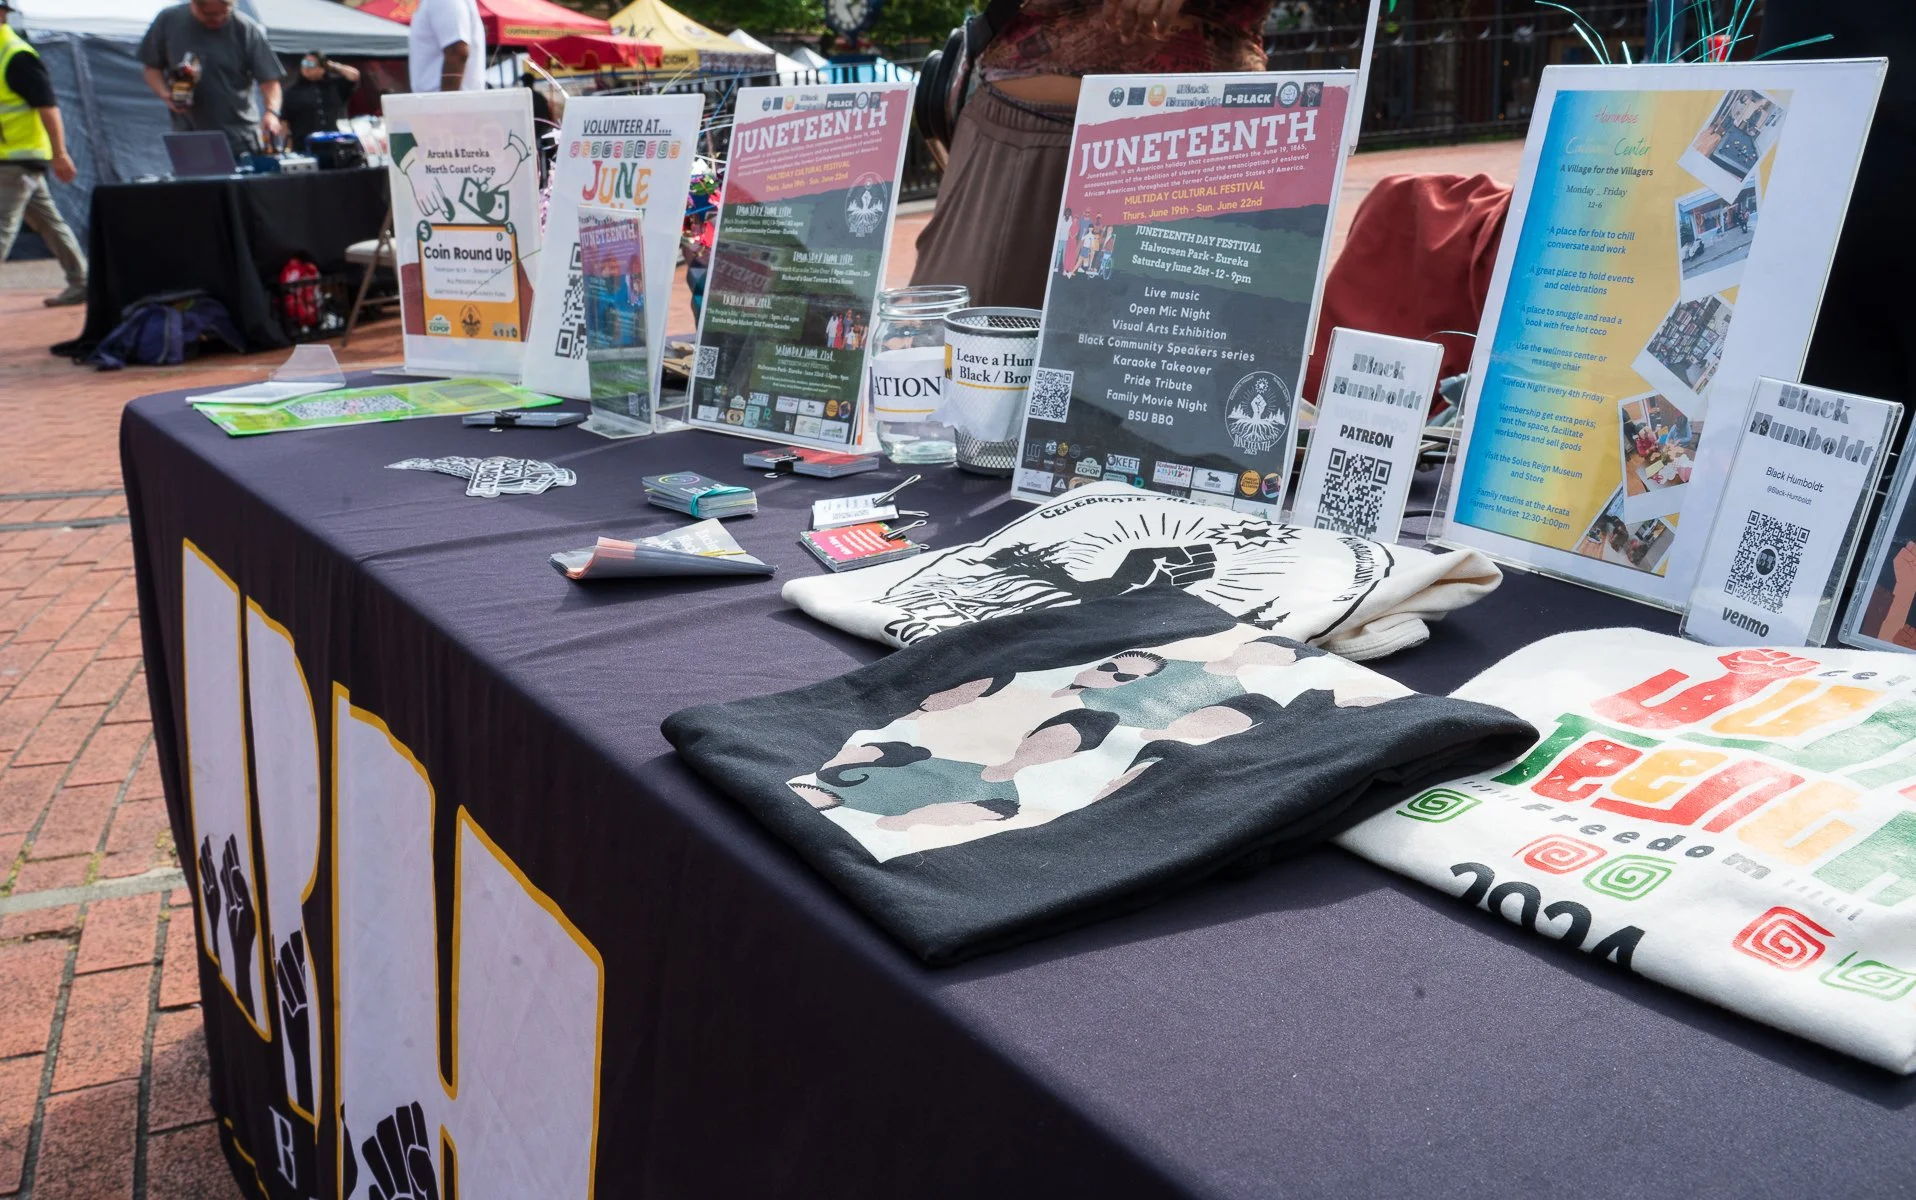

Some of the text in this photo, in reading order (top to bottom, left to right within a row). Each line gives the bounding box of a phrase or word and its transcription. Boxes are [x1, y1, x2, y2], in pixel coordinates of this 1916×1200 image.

[1226, 93, 1270, 104] B-BLACK
[583, 119, 643, 134] VOLUNTEER
[735, 102, 888, 157] JUNETEENTH
[1079, 109, 1318, 177] JUNETEENTH
[1614, 137, 1653, 156] Center
[427, 149, 490, 159] Arcata Eureka
[425, 165, 496, 176] North Coast Co-op
[823, 161, 850, 171] FESTIVAL
[1566, 164, 1654, 177] Village for the Villagers
[582, 160, 652, 206] JUNE
[1124, 180, 1265, 206] MULTIDAY CULTURAL FESTIVAL
[1566, 185, 1628, 198] Monday Friday
[1123, 196, 1263, 221] Thurs. June 19th Sun. June 22nd
[1588, 201, 1603, 209] 12-6
[581, 222, 636, 248] JUNETEENTH
[1136, 225, 1262, 254] JUNETEENTH DAY FESTIVAL
[1556, 227, 1577, 239] place
[1578, 227, 1589, 237] for
[1607, 230, 1616, 239] to
[1617, 230, 1635, 240] chill
[424, 243, 512, 264] Coin Round Up
[1140, 240, 1249, 268] Halvorsen Park Eureka
[1547, 241, 1626, 254] conversate and work
[1131, 254, 1252, 284] Saturday June 21st 12 9pm
[1536, 267, 1635, 284] great place to hold events
[1144, 286, 1200, 301] Live music
[1544, 281, 1607, 295] and celebrations
[1129, 303, 1211, 321] Open Mic Night
[1526, 306, 1616, 324] place snuggle and read
[1112, 319, 1227, 340] Visual Arts Exhibition
[1525, 318, 1607, 336] book with free hot coco
[956, 348, 988, 366] Leave
[992, 356, 999, 366] a
[1078, 333, 1255, 362] Black Community Speakers series
[1530, 344, 1541, 353] the
[1543, 346, 1572, 358] wellness
[1574, 350, 1598, 361] center
[959, 366, 991, 383] Black
[1112, 354, 1212, 375] Karaoke Takeover
[1352, 353, 1406, 380] Black
[1532, 358, 1581, 372] massage chair
[1123, 373, 1193, 392] Pride Tribute
[1332, 375, 1423, 411] Humboldt
[1527, 382, 1604, 404] Night every 4th Friday
[1106, 389, 1208, 413] Family Movie Night
[1778, 384, 1852, 424] Black
[1127, 409, 1174, 426] BSU BBQ
[1500, 416, 1584, 439] rent the space, facilitate
[1541, 411, 1554, 421] get
[1555, 413, 1573, 423] extra
[1339, 424, 1394, 449] PATREON
[1494, 429, 1582, 452] workshops and sell goods
[1749, 412, 1874, 466] Humboldt
[1499, 453, 1511, 463] the
[1512, 456, 1531, 467] Soles
[1532, 460, 1551, 473] Reign
[1552, 465, 1583, 479] Museum
[1510, 469, 1544, 484] and Store
[1765, 466, 1825, 493] Black Humboldt
[1477, 487, 1570, 517] Family at the Arcata
[1766, 485, 1812, 506] @Black-Humboldt
[1495, 504, 1571, 531] Market 12:30-1:00pm
[1722, 606, 1770, 638] venmo
